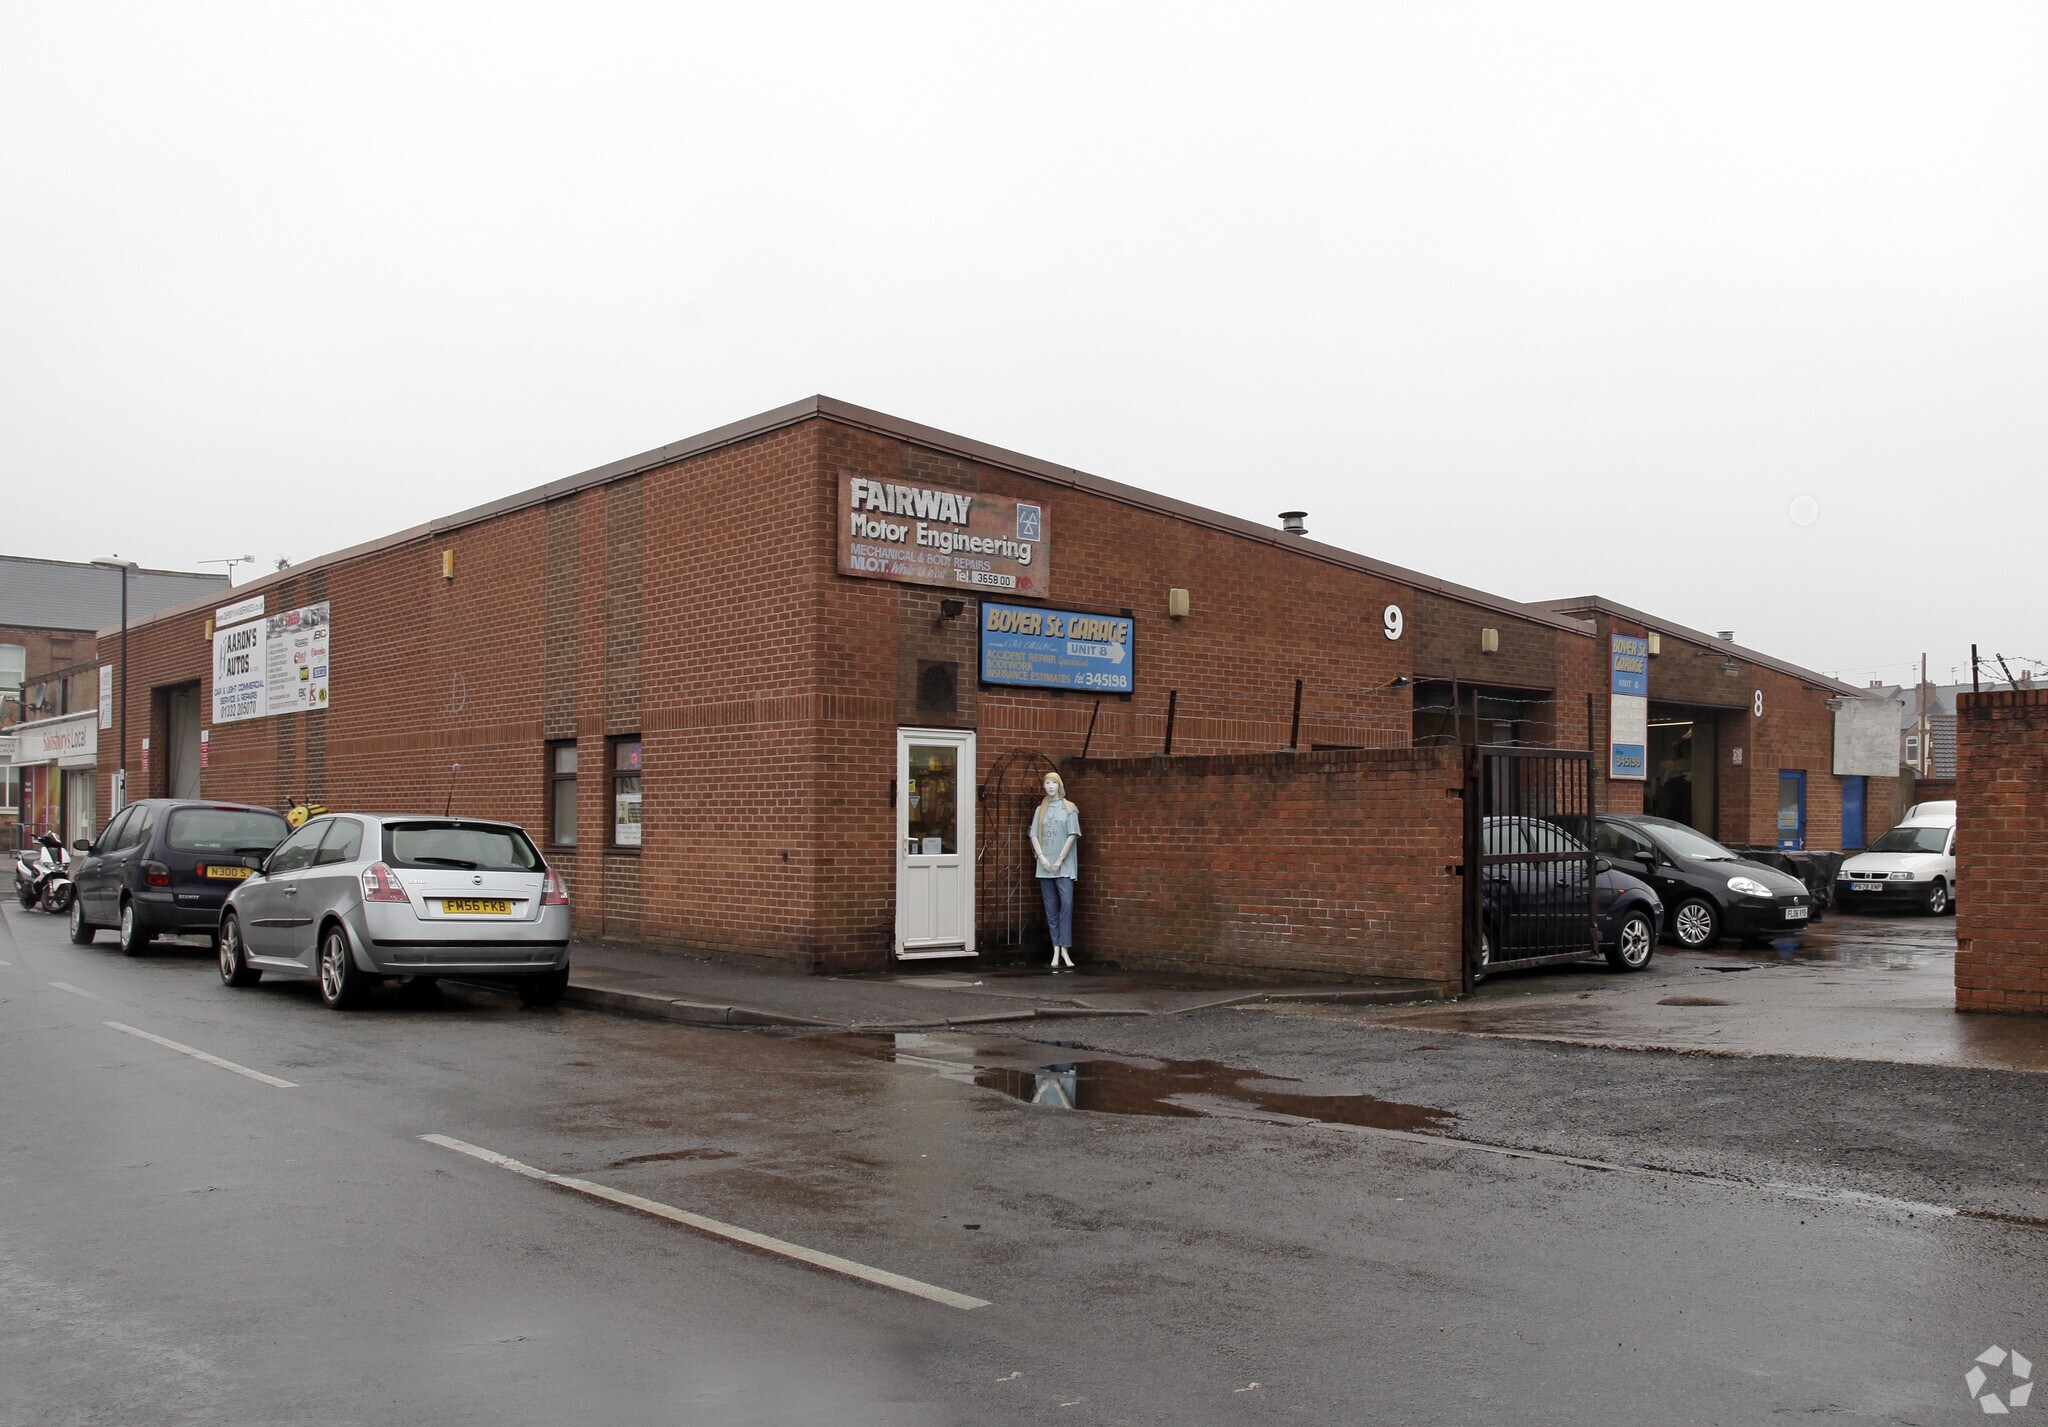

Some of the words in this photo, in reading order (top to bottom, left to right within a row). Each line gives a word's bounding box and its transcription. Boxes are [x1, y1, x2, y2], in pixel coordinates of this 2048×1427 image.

[850, 477, 972, 525] FAIRWAY
[850, 512, 909, 542] Motor
[916, 522, 1032, 565] Engineering
[850, 543, 916, 562] MECHANICAL
[917, 552, 925, 563] &
[927, 553, 952, 567] BODY
[954, 557, 991, 571] REPAIRS
[954, 568, 971, 583] Tel.
[986, 607, 1042, 637] BOYER
[1067, 616, 1129, 644] GARAGE
[1384, 604, 1403, 640] 9
[227, 627, 257, 653] AARON'S
[1612, 639, 1638, 657] BOYER
[986, 649, 1026, 661] ACCIDENT
[1029, 653, 1057, 664] REPAIR
[1071, 643, 1096, 656] UNIT
[1099, 646, 1108, 656] 8
[226, 653, 249, 677] AUTOS
[986, 659, 1034, 671] BODYWORK
[1615, 656, 1644, 674] GARAGE
[986, 668, 1027, 680] INSURANCE
[1031, 672, 1071, 683] ESTIMATES
[1085, 672, 1127, 688] 345198
[1618, 680, 1632, 688] UNIT
[1634, 681, 1640, 689] 8
[214, 687, 222, 697] CAR
[226, 684, 237, 694] LIGHT
[238, 680, 265, 692] COMMERCIAL
[220, 695, 236, 705] SERVICE
[240, 691, 258, 701] REPAIRS
[1754, 689, 1763, 717] 8
[220, 704, 236, 719] 01332
[43, 729, 70, 754] Sainsbury's
[71, 725, 87, 749] Local
[1616, 756, 1642, 768] 345198
[212, 867, 238, 877] N300
[447, 899, 480, 911] FM56
[483, 900, 506, 912] FKB
